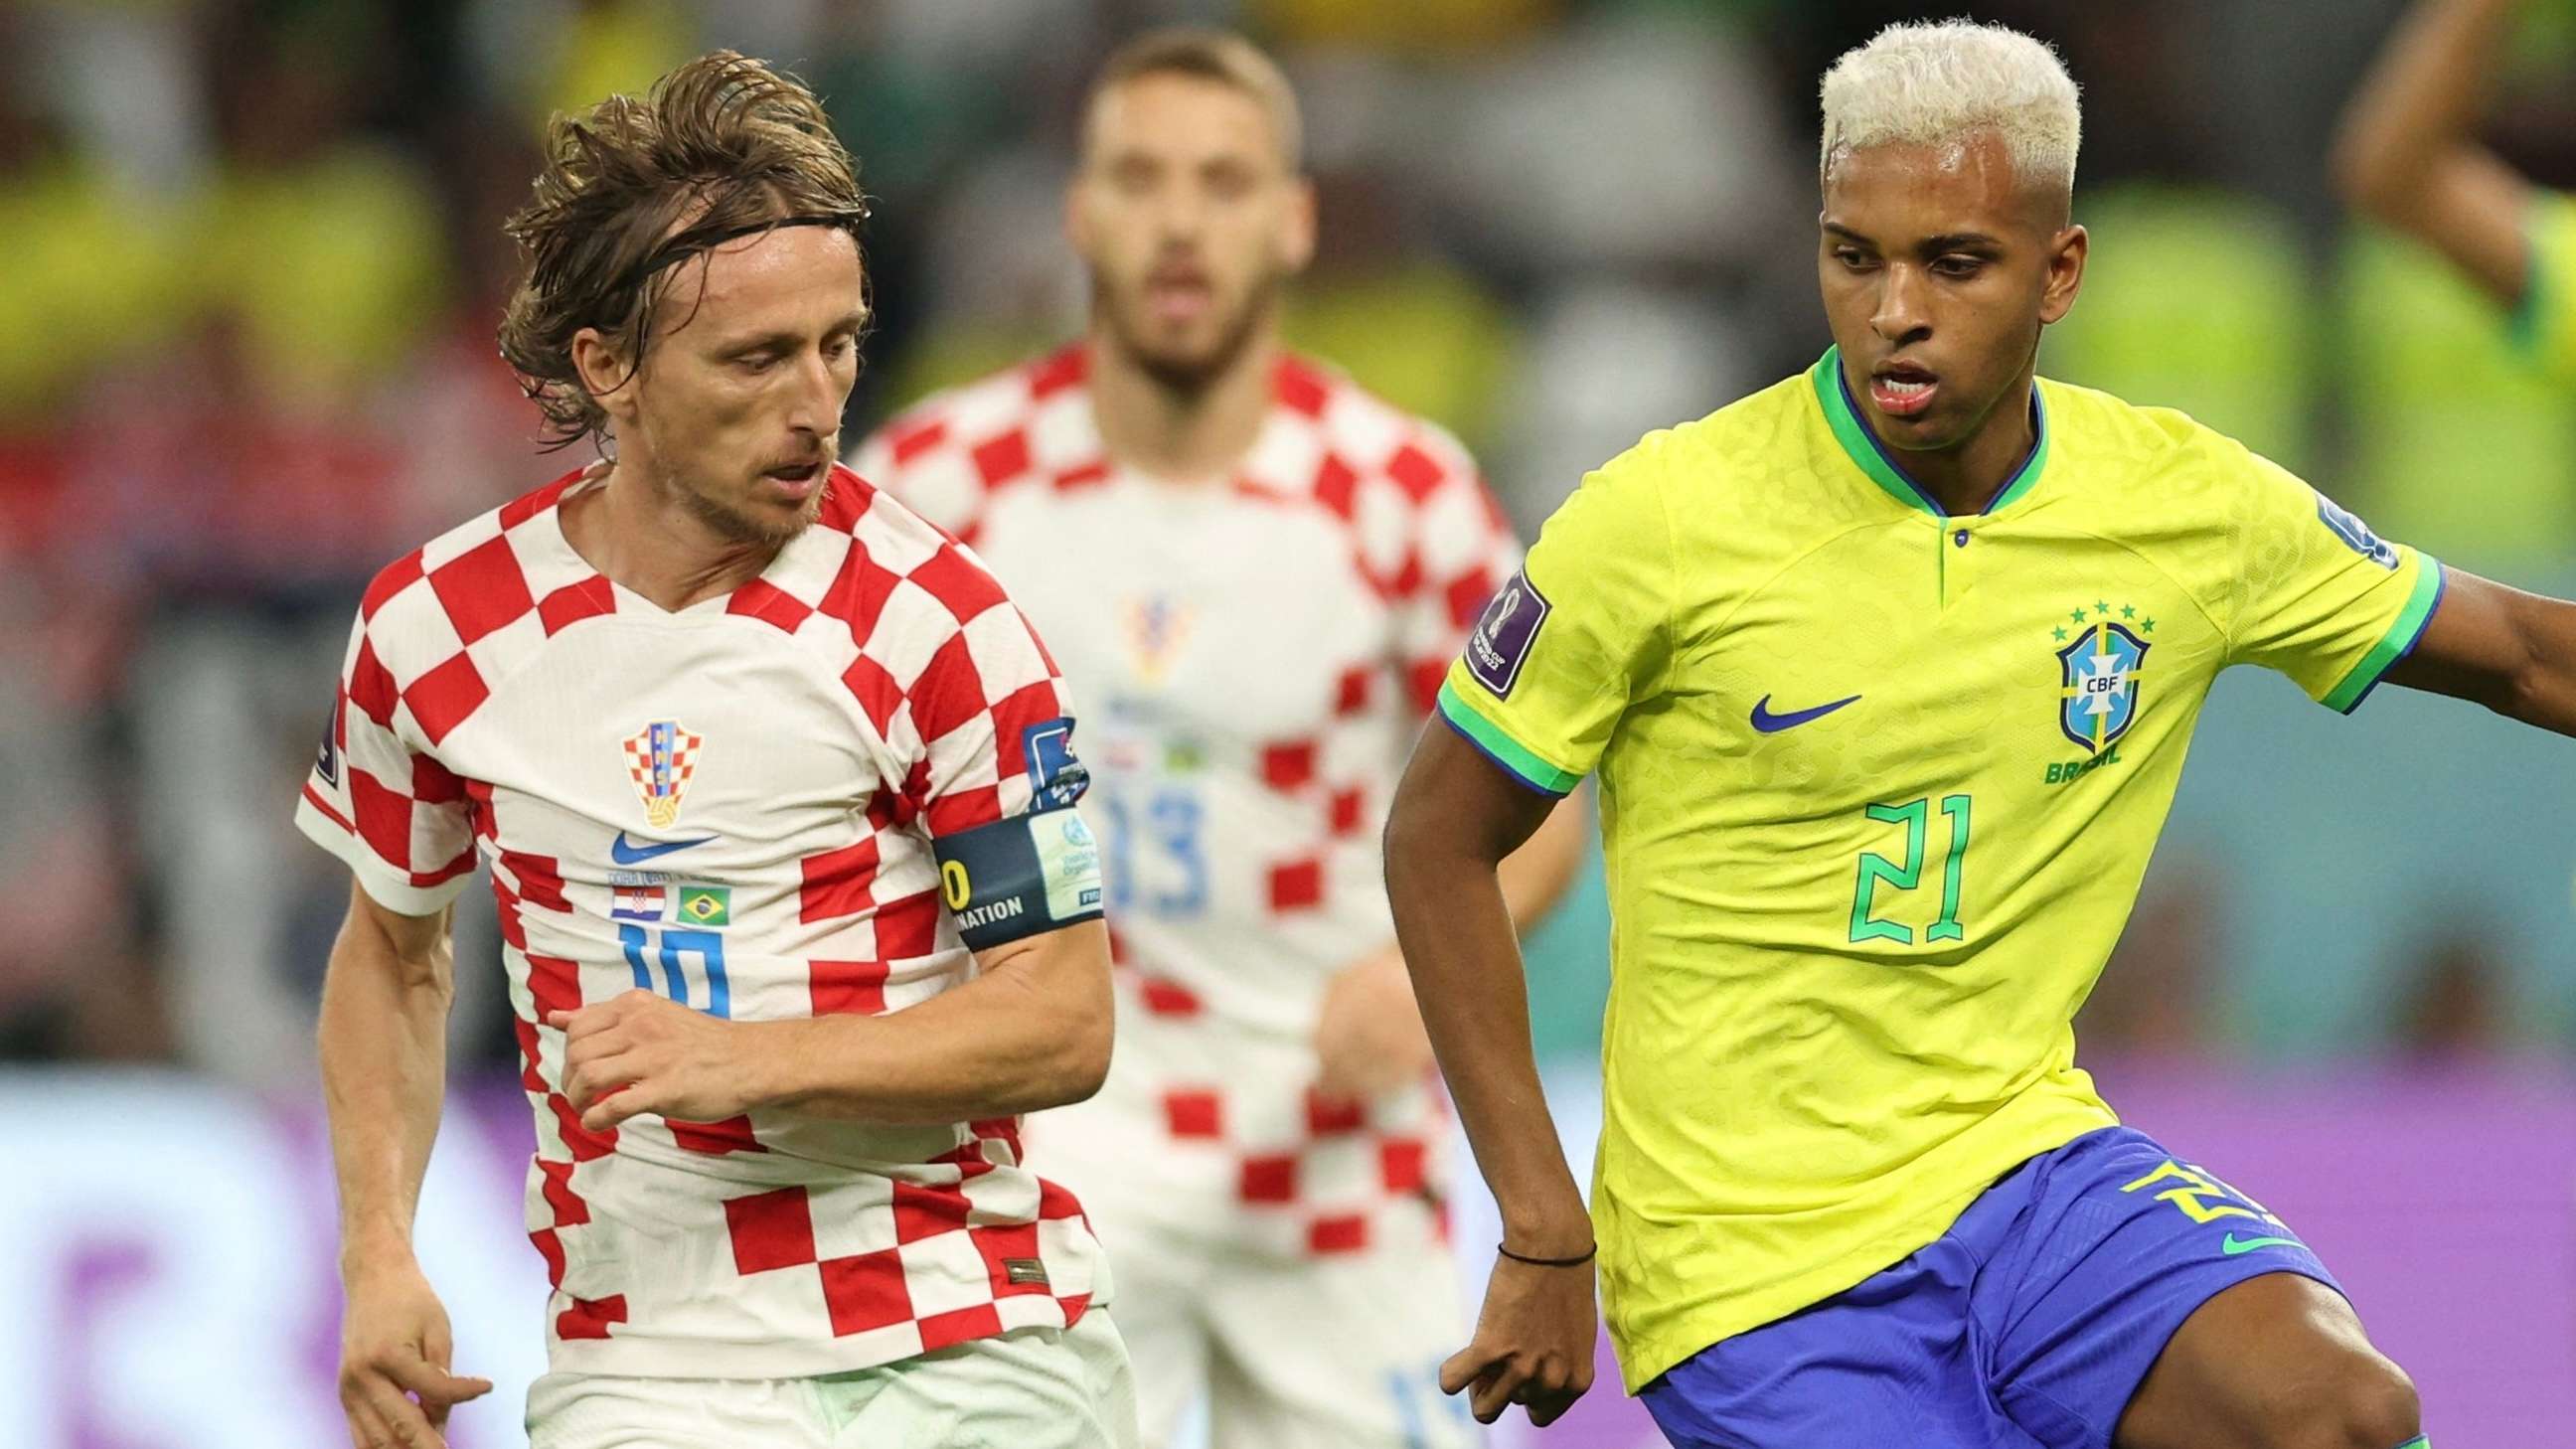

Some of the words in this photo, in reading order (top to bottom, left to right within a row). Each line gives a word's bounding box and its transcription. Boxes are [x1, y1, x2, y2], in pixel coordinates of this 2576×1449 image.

[2087, 677, 2118, 693] CBF
[1097, 792, 1208, 920] 13
[1849, 795, 1972, 946] 21
[955, 895, 1024, 930] NATION
[618, 922, 731, 1020] 10
